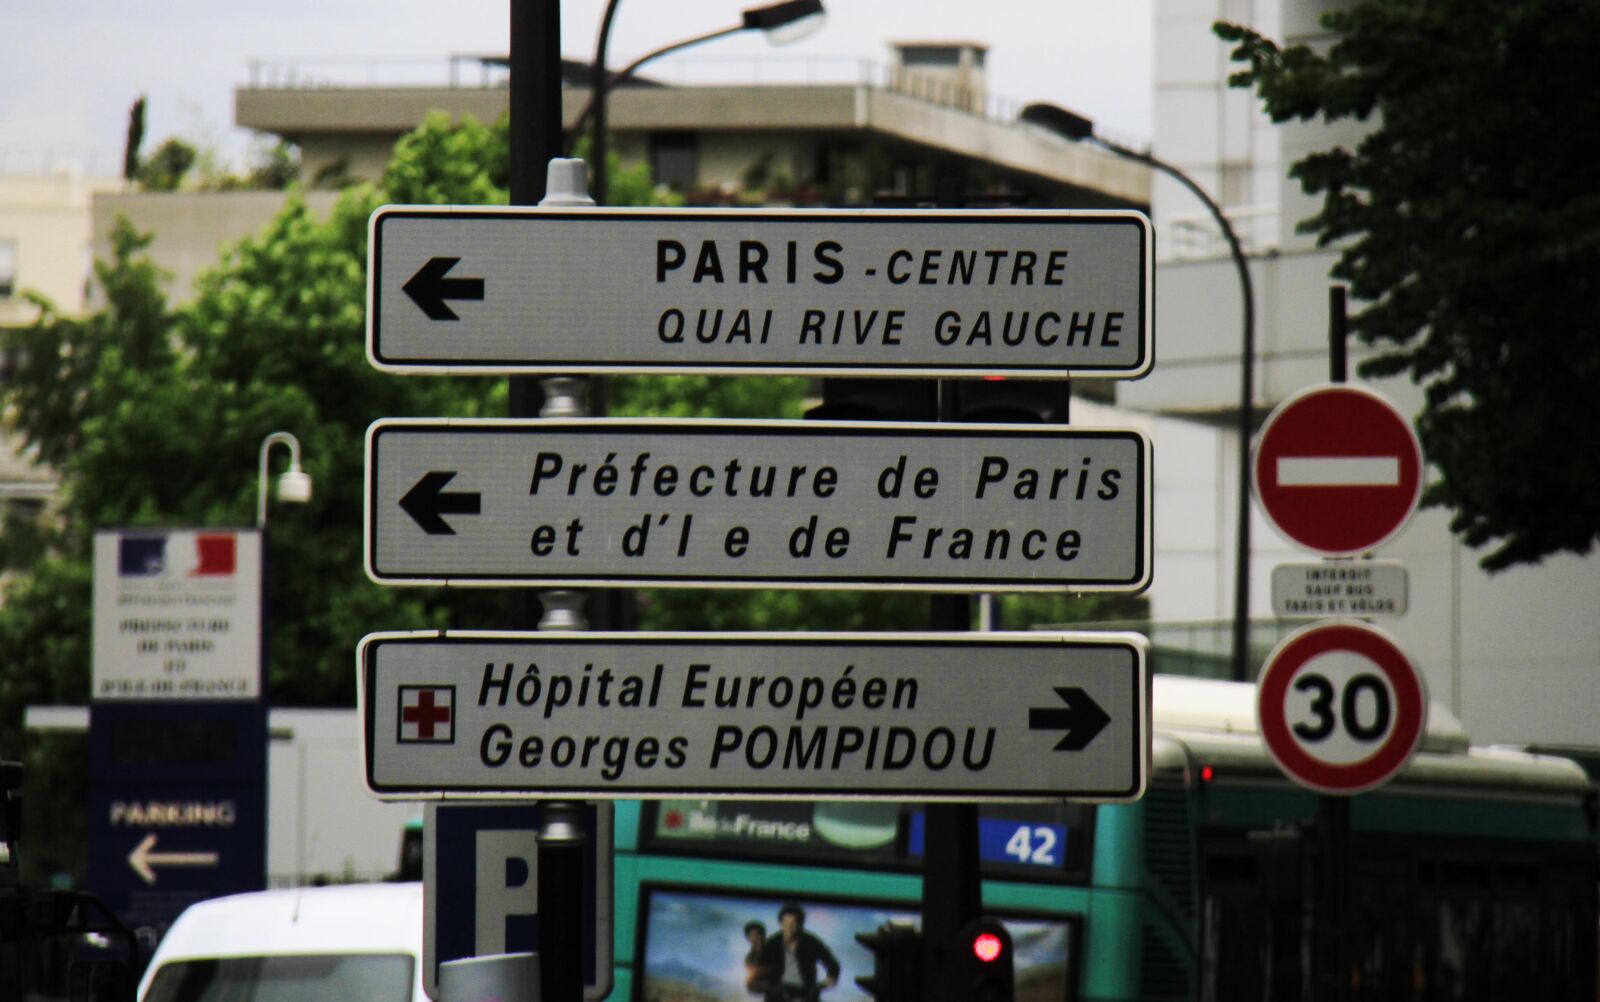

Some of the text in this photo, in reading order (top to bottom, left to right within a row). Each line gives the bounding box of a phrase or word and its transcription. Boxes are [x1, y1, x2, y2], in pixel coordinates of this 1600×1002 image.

[656, 239, 845, 285] PARIS
[657, 308, 1125, 348] QUAI RIVE GAUCHE
[529, 451, 1122, 502] Préfecture de Paris
[530, 517, 584, 557] et
[788, 514, 851, 560] de
[885, 515, 1082, 562] France
[477, 662, 919, 722] Hôpital Européen
[1293, 673, 1391, 743] 30
[479, 722, 997, 783] Georges POMPIDOU
[110, 802, 235, 825] PARKING
[1005, 825, 1056, 864] 42
